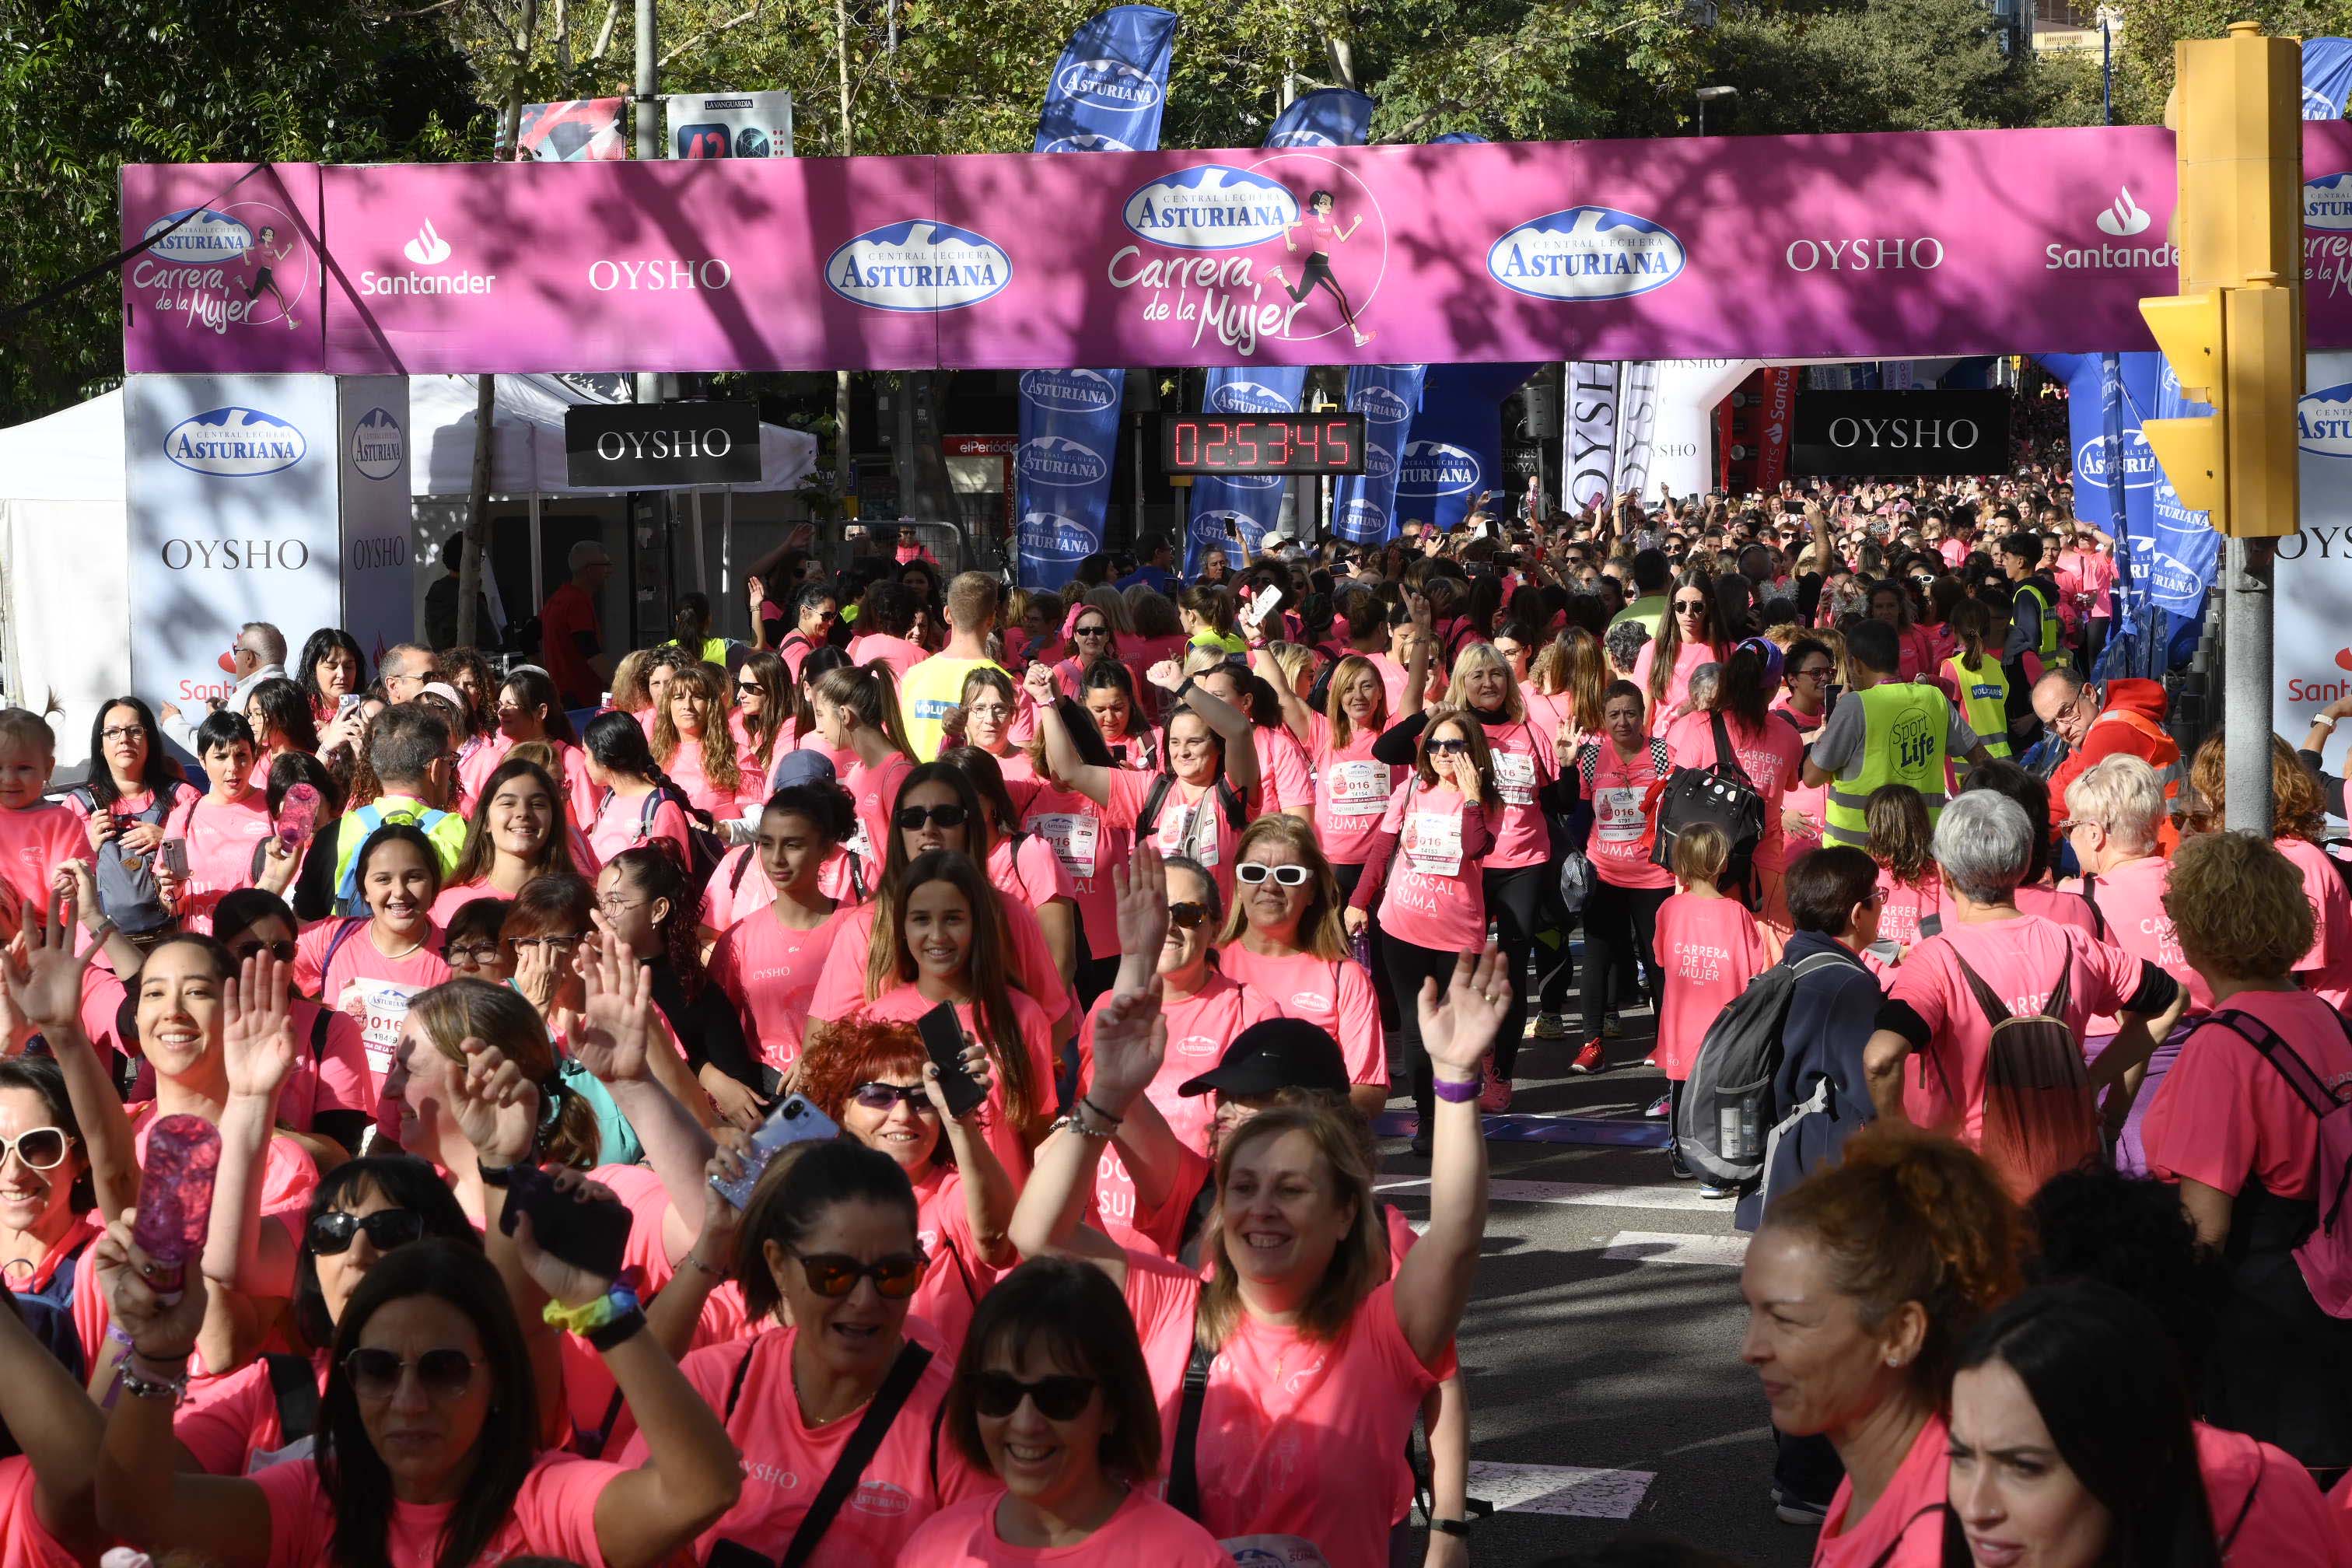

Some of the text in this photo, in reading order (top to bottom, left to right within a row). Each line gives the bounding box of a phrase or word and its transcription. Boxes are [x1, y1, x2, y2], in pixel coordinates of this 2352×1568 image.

[1064, 71, 1152, 103] ASTURIANA
[1164, 193, 1281, 204] CENTRAL LECHERA
[1136, 197, 1285, 229] ASTURIANA
[151, 229, 244, 250] ASTURIANA
[1533, 237, 1664, 250] CENTRAL LECHERA
[868, 250, 992, 261] CENTRAL LECHERA
[1108, 245, 1254, 289] Carrera
[1503, 243, 1671, 278] ASTURIANA
[1786, 237, 1944, 272] OYSHO
[133, 260, 224, 289] Carrera
[588, 259, 732, 292] OYSHO
[840, 255, 997, 289] ASTURIANA
[2319, 258, 2332, 280] la
[361, 271, 496, 296] Santander
[156, 286, 259, 334] de la Mujer
[1143, 283, 1307, 356] de la Mujer
[1027, 375, 1108, 404] ASTURIANA
[245, 431, 292, 439] LECHERA
[597, 428, 732, 460] OYSHO
[1175, 422, 1349, 466] 02:53:45
[1829, 416, 1979, 450] OYSHO
[175, 432, 296, 460] ASTURIANA
[355, 435, 401, 462] ASTURIANA
[1022, 449, 1098, 478] ASTURIANA
[161, 538, 310, 570] OYSHO
[353, 535, 405, 571] OYSHO
[1020, 532, 1090, 554] STURIANA
[179, 679, 236, 701] Sant
[1892, 713, 1929, 744] Sport
[1735, 747, 1783, 767] CARRERA
[1900, 733, 1934, 768] Life
[1744, 760, 1775, 775] DE LA
[1349, 781, 1370, 790] 016
[1326, 817, 1370, 831] SUMA
[1614, 808, 1634, 817] 016
[1419, 837, 1441, 847] 016
[1596, 839, 1635, 857] SUMA
[1880, 905, 1924, 918] ARRERA
[1882, 916, 1915, 928] DE LA
[1675, 943, 1730, 961] CARRERA
[1682, 955, 1718, 970] DE LA
[1678, 966, 1720, 982] MUJER
[370, 1017, 404, 1033] 016
[766, 1045, 794, 1063] TU
[739, 1460, 798, 1489] YSHO
